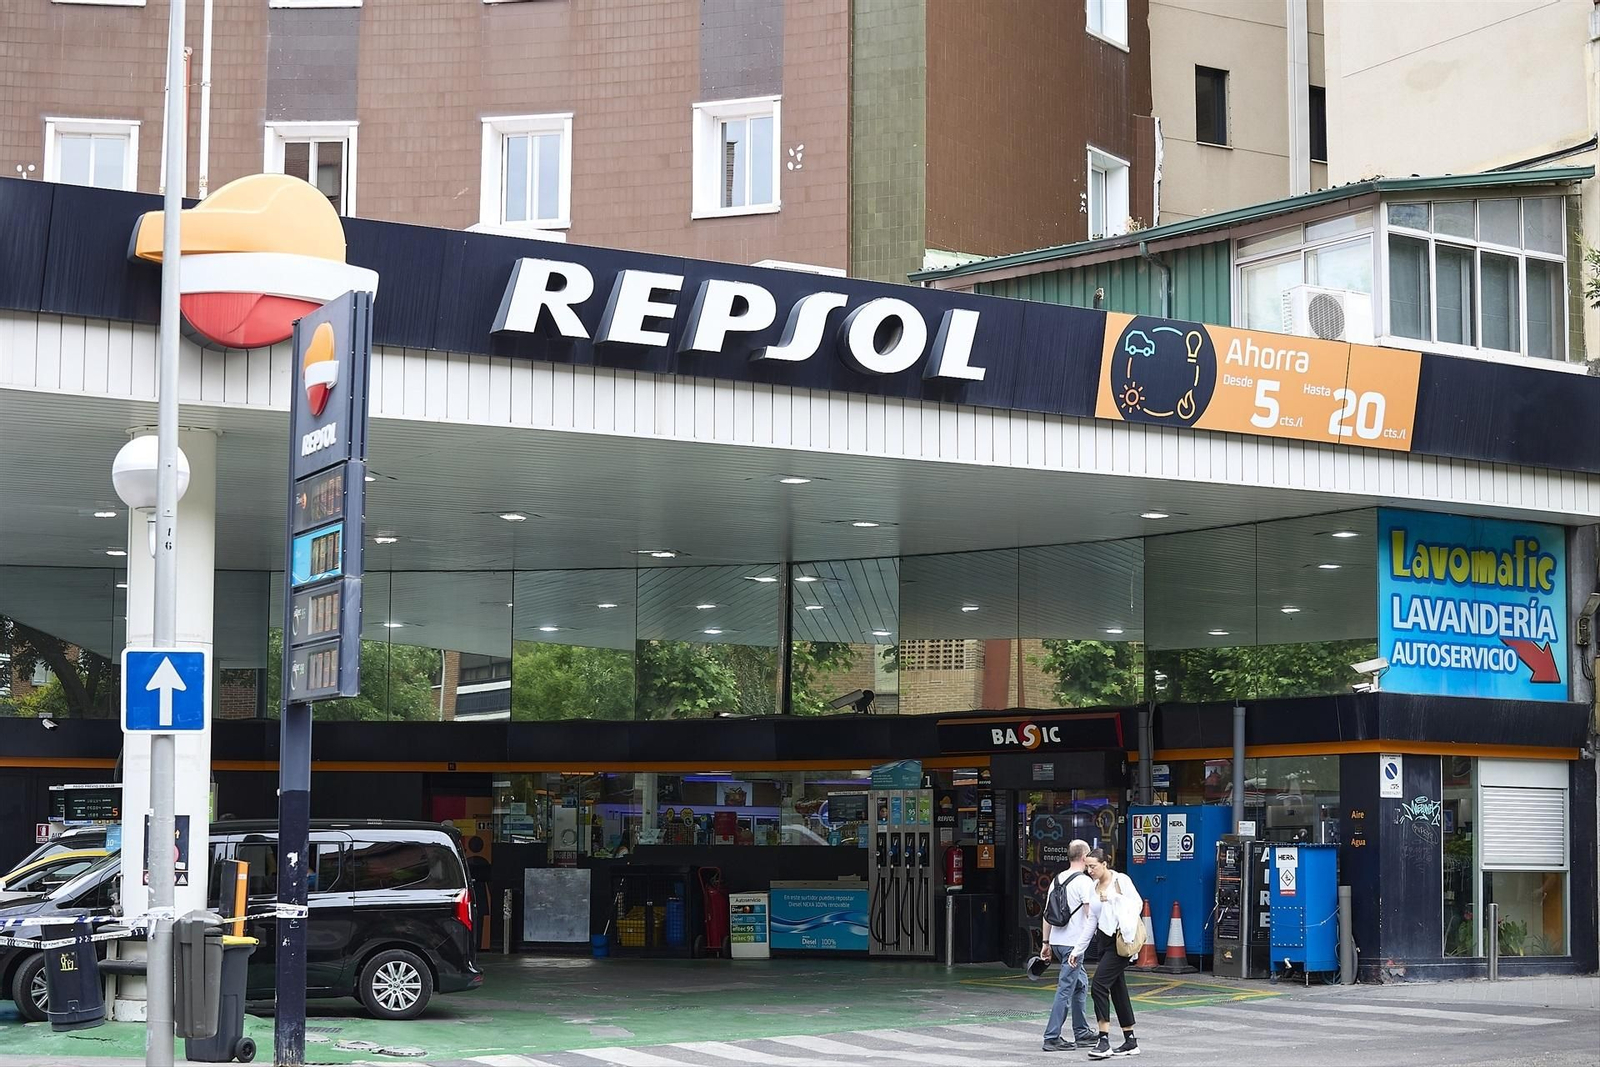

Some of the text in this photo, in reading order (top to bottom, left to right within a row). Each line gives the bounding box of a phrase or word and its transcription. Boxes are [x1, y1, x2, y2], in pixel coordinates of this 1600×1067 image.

[490, 257, 986, 381] REPSOL
[1225, 338, 1309, 373] Ahorra
[1223, 374, 1253, 388] Desde
[1250, 379, 1281, 429] 5
[1303, 383, 1331, 397] Hasta
[1328, 388, 1386, 440] 20
[301, 422, 337, 457] REPSOL
[1391, 530, 1554, 590] Lavomatic
[1392, 596, 1557, 640] LAVANDERÍA
[1391, 641, 1517, 672] AUTOSERVICIO
[991, 724, 1061, 747] BASIC
[924, 775, 932, 788] 1
[1351, 810, 1365, 819] Aire
[1043, 854, 1069, 863] energías
[1350, 838, 1366, 848] Agua
[822, 938, 836, 946] 100%
